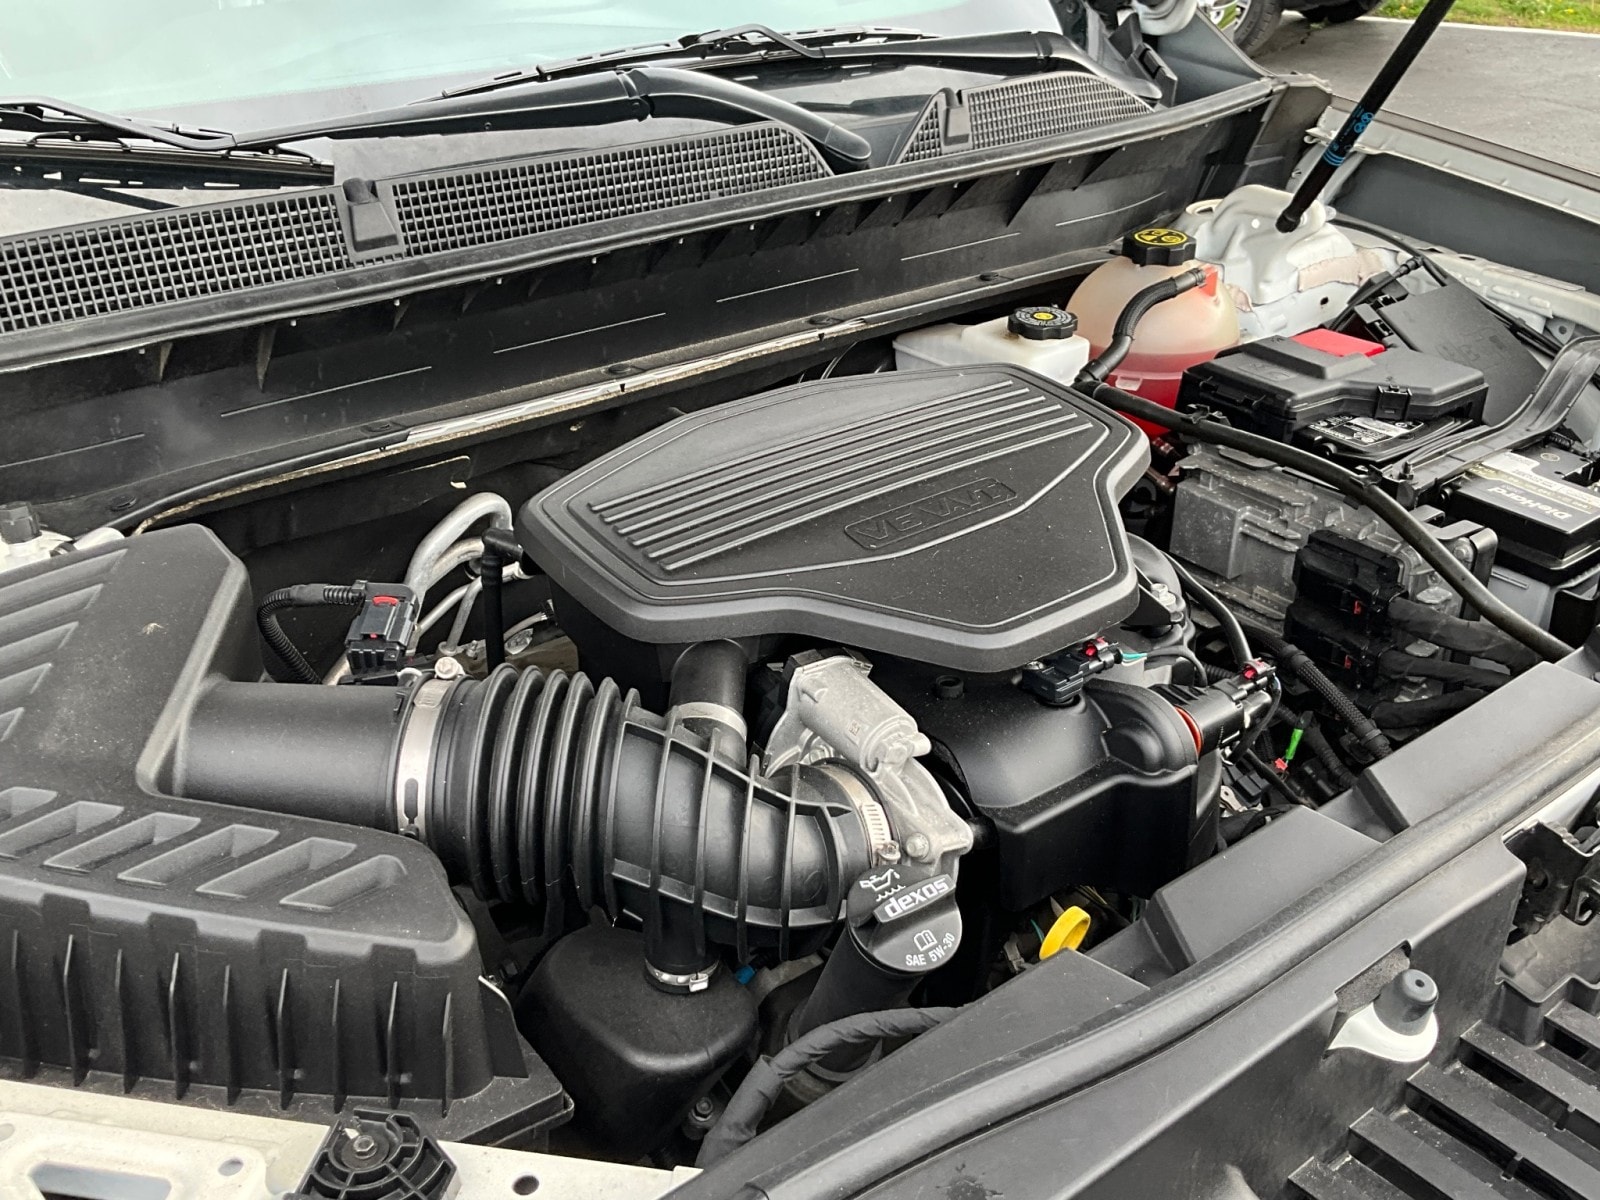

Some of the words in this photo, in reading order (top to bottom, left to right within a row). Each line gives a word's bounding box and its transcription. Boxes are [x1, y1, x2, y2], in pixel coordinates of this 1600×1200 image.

[1487, 487, 1572, 520] DieHard
[884, 878, 949, 918] dexos
[905, 954, 927, 967] SAE
[928, 932, 955, 962] 5W-30
